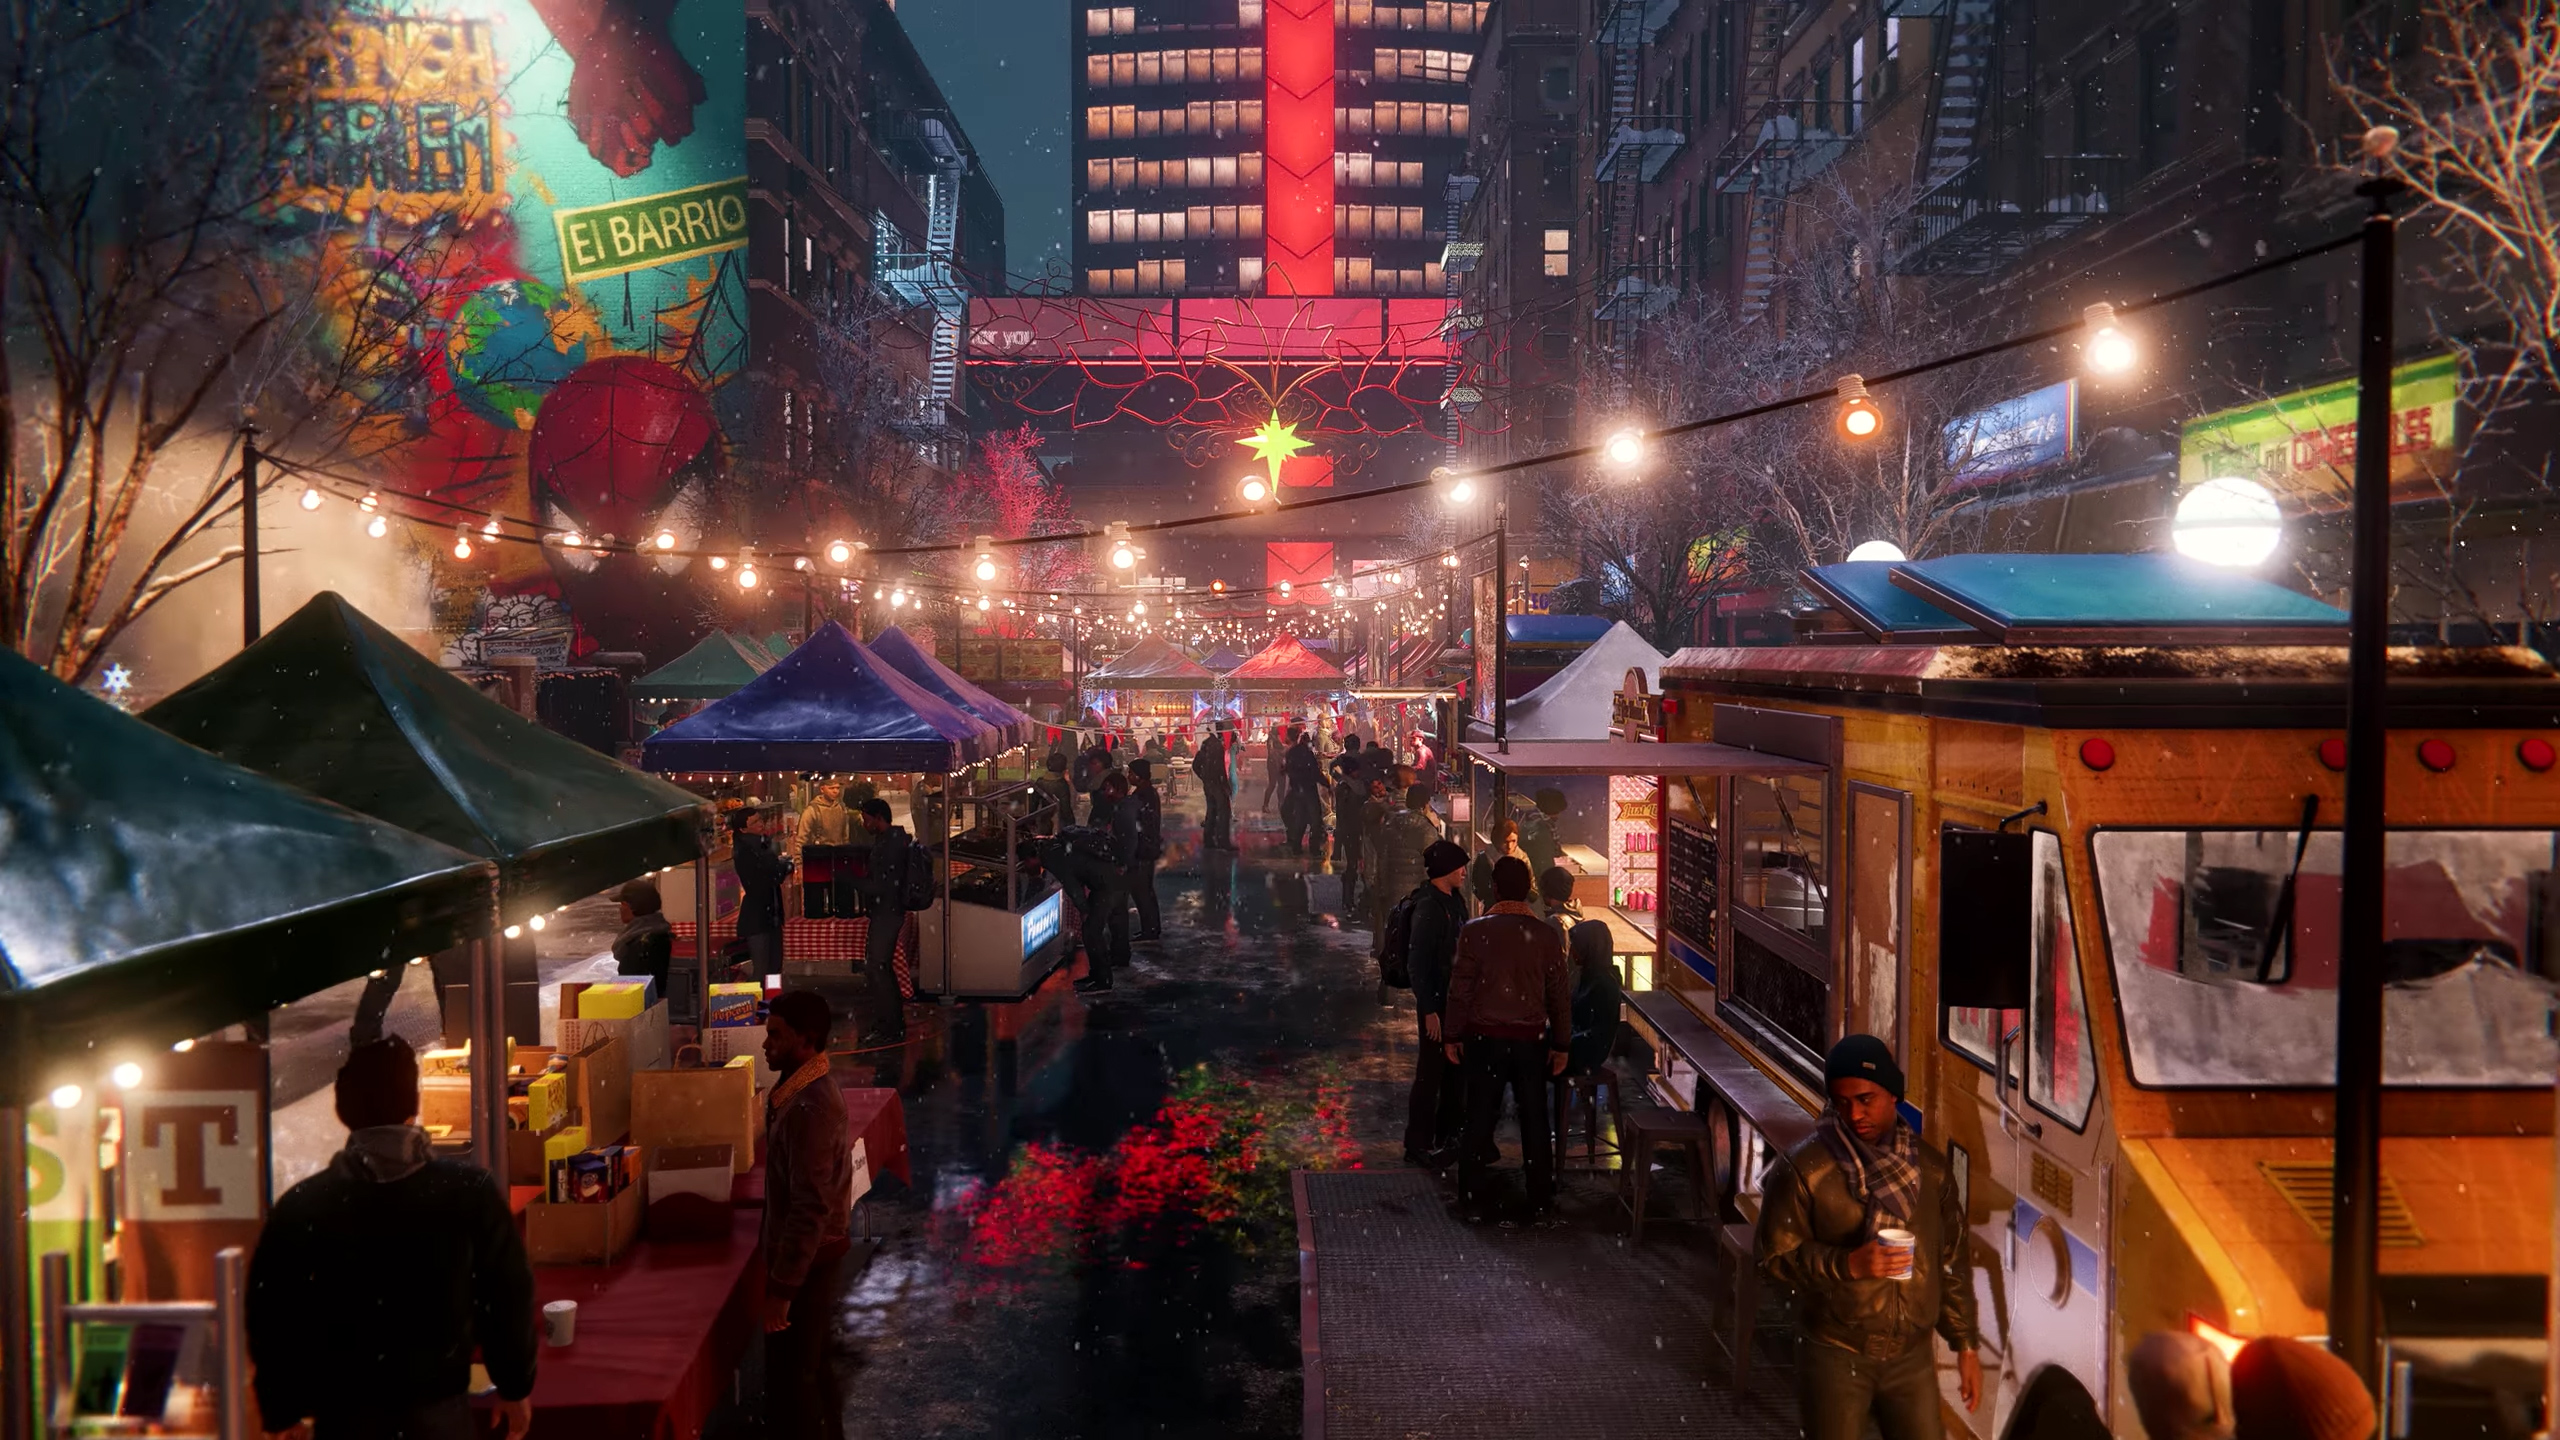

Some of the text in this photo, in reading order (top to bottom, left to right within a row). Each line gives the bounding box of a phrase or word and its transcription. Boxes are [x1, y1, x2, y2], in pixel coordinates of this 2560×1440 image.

[609, 195, 746, 257] BARRIO
[1621, 802, 1645, 820] Just
[141, 1105, 239, 1206] T
